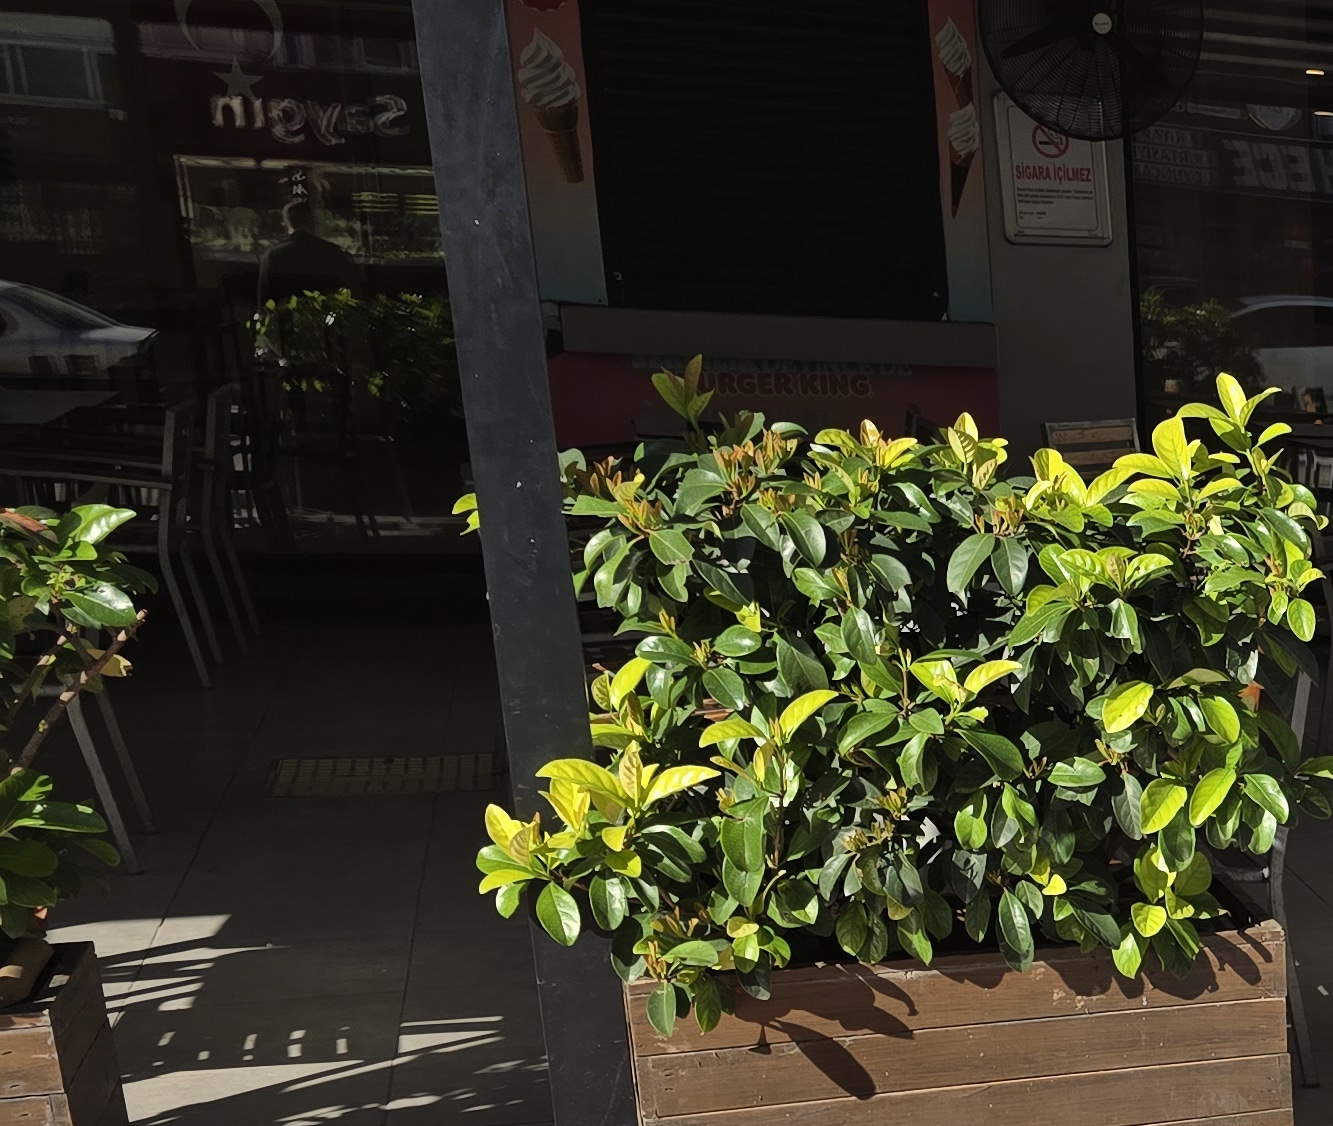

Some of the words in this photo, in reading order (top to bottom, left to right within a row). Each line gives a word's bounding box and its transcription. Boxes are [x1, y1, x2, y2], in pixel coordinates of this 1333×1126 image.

[1015, 162, 1051, 181] SİGARA
[698, 371, 793, 395] URGER
[798, 373, 871, 396] KING
